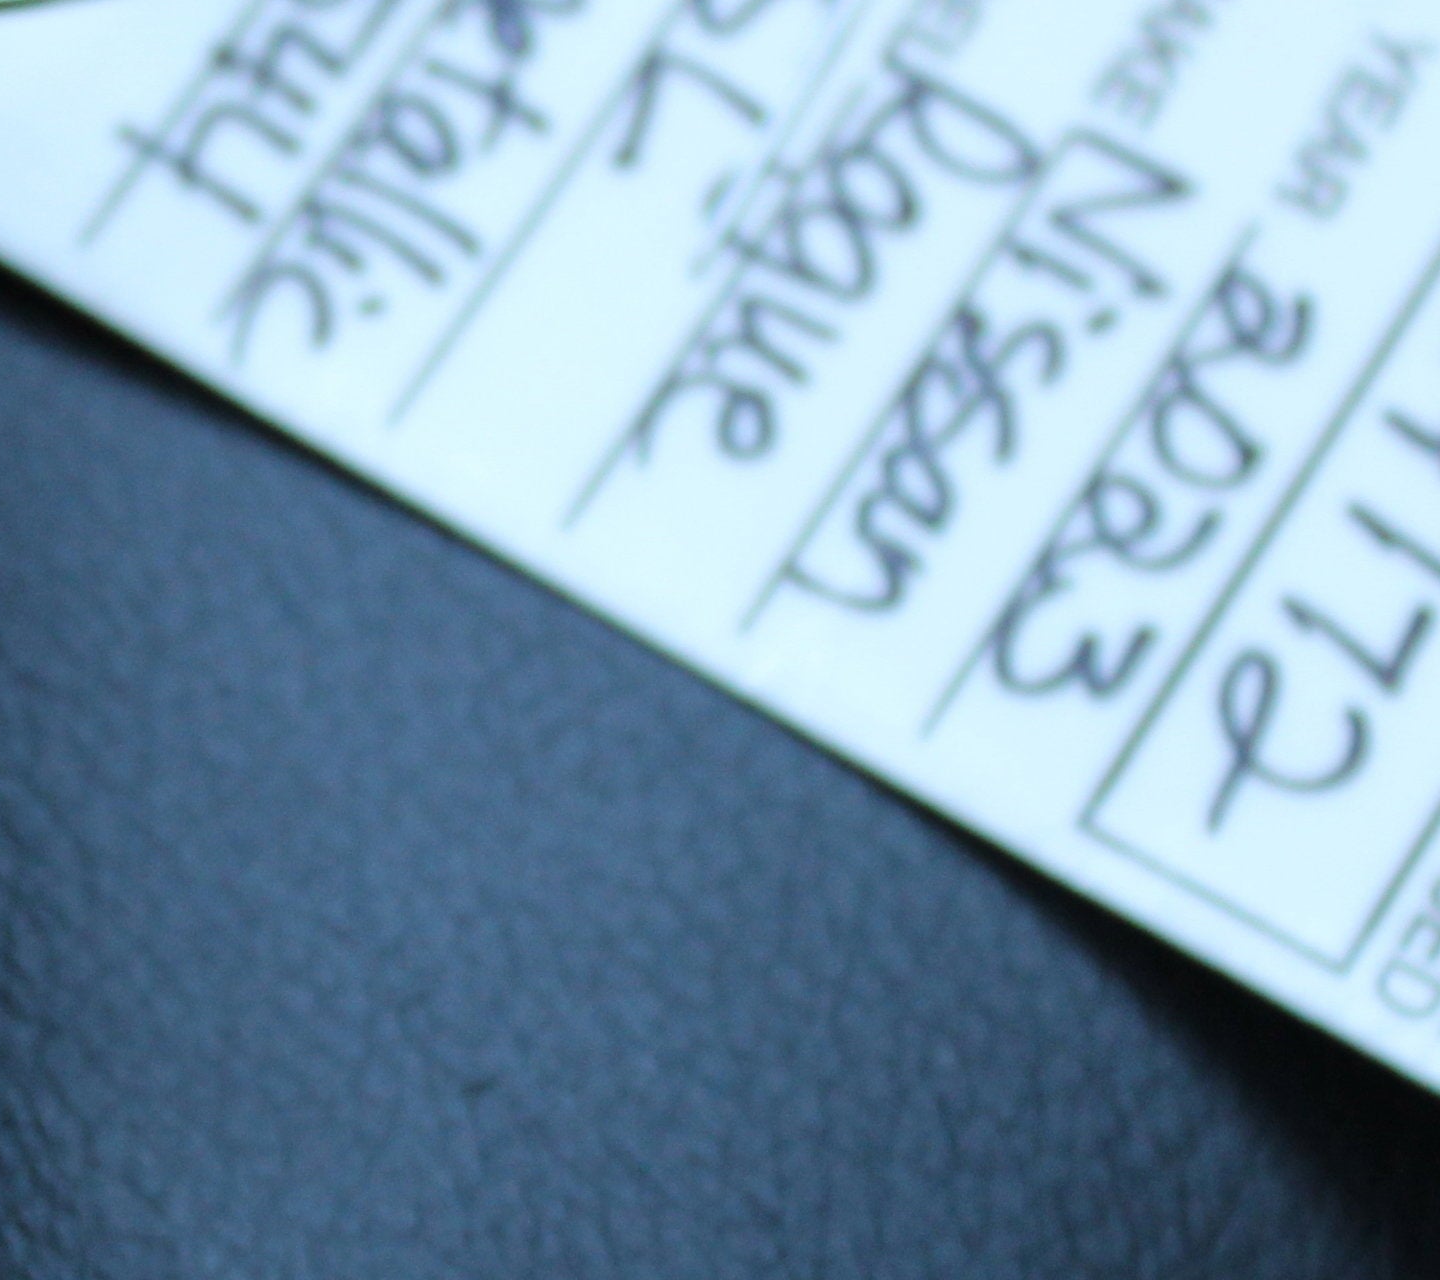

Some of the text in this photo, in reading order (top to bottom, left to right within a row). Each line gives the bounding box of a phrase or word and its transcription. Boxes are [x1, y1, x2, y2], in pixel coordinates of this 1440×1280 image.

[1272, 28, 1435, 222] YEAR
[778, 131, 1190, 615] Nissan
[990, 265, 1315, 701] 2023
